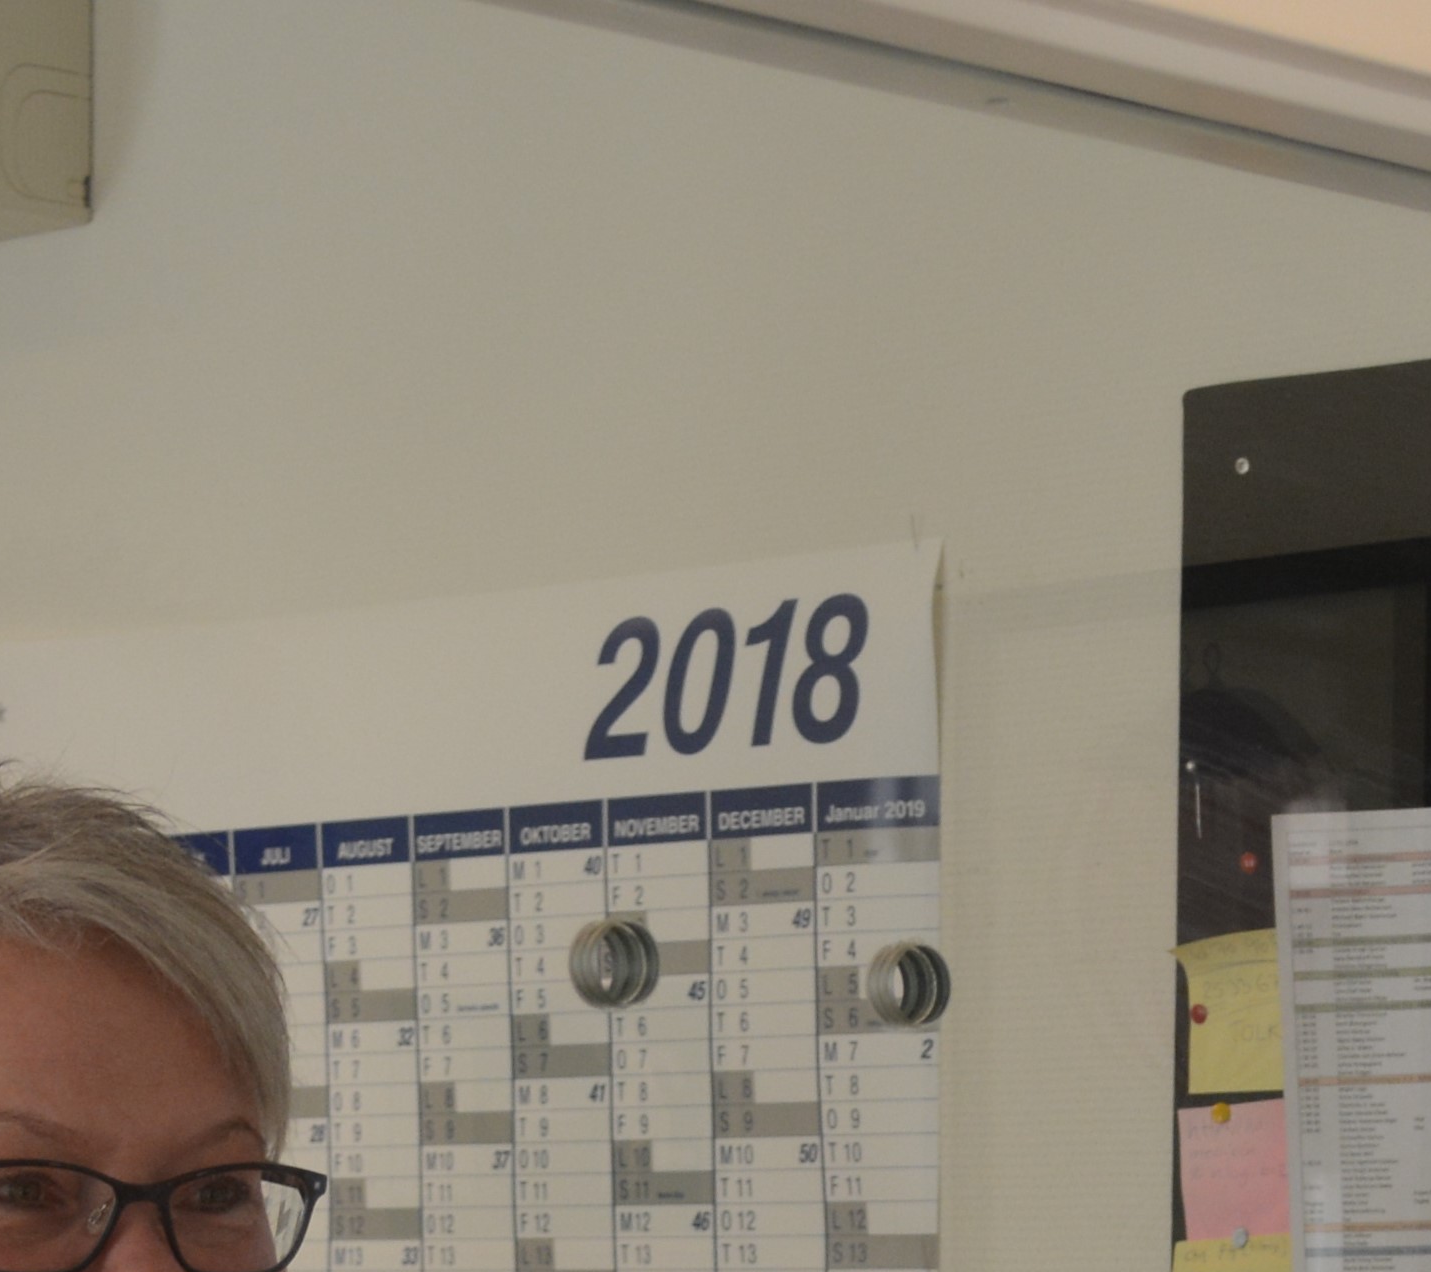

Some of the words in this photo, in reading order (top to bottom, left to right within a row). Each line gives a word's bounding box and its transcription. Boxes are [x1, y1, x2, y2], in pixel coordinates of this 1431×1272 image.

[583, 592, 870, 762] 2018
[718, 806, 805, 830] DECEMBER
[825, 803, 879, 823] Januar
[884, 799, 926, 819] 2019
[520, 823, 592, 847] OKTOBER
[614, 813, 700, 838] NOVEMBER
[337, 838, 394, 859] AUGUST
[416, 829, 502, 854] SEPTEMBER
[261, 848, 291, 865] JULI
[583, 855, 602, 875] 40
[611, 854, 620, 874] T
[634, 855, 640, 873] 1
[821, 872, 831, 892] O
[846, 872, 855, 892] 2
[611, 886, 620, 904] F
[634, 886, 643, 904] 2
[302, 908, 320, 926] 27
[717, 913, 729, 932] M
[740, 913, 749, 932] 3
[792, 908, 811, 928] 49
[822, 907, 830, 926] T
[846, 907, 856, 926] 3
[488, 928, 505, 946] 36
[717, 946, 725, 965] T
[740, 946, 750, 965] 4
[822, 940, 831, 960] F
[847, 940, 857, 960] 4
[688, 980, 706, 1000] 45
[717, 979, 726, 998] O
[740, 979, 750, 998] 5
[616, 1016, 625, 1036] T
[637, 1016, 647, 1036] 6
[717, 1012, 725, 1032] T
[741, 1012, 750, 1032] 6
[397, 1027, 414, 1046] 32
[617, 1050, 625, 1068] O
[637, 1050, 647, 1068] 7
[717, 1045, 726, 1064] F
[741, 1045, 750, 1064] 7
[825, 1042, 837, 1061] M
[849, 1042, 859, 1061] 7
[921, 1038, 934, 1060] 2
[589, 1084, 606, 1102] 41
[617, 1082, 625, 1101] T
[638, 1082, 647, 1101] 8
[826, 1076, 834, 1095] T
[850, 1076, 859, 1095] 8
[617, 1114, 626, 1134] F
[639, 1114, 649, 1134] 9
[827, 1109, 836, 1128] O
[851, 1109, 860, 1128] 9
[493, 1150, 510, 1169] 37
[799, 1143, 818, 1163] 50
[829, 1142, 837, 1162] T
[844, 1142, 861, 1162] 10
[721, 1178, 730, 1197] T
[737, 1178, 754, 1197] 11
[830, 1176, 838, 1195] F
[845, 1176, 863, 1195] 11
[692, 1211, 710, 1230] 46
[722, 1212, 731, 1230] O
[738, 1212, 755, 1230] 12
[402, 1247, 419, 1265] 33
[621, 1245, 629, 1264] T
[634, 1245, 651, 1264] 13
[723, 1245, 731, 1264] T
[739, 1245, 757, 1264] 13
